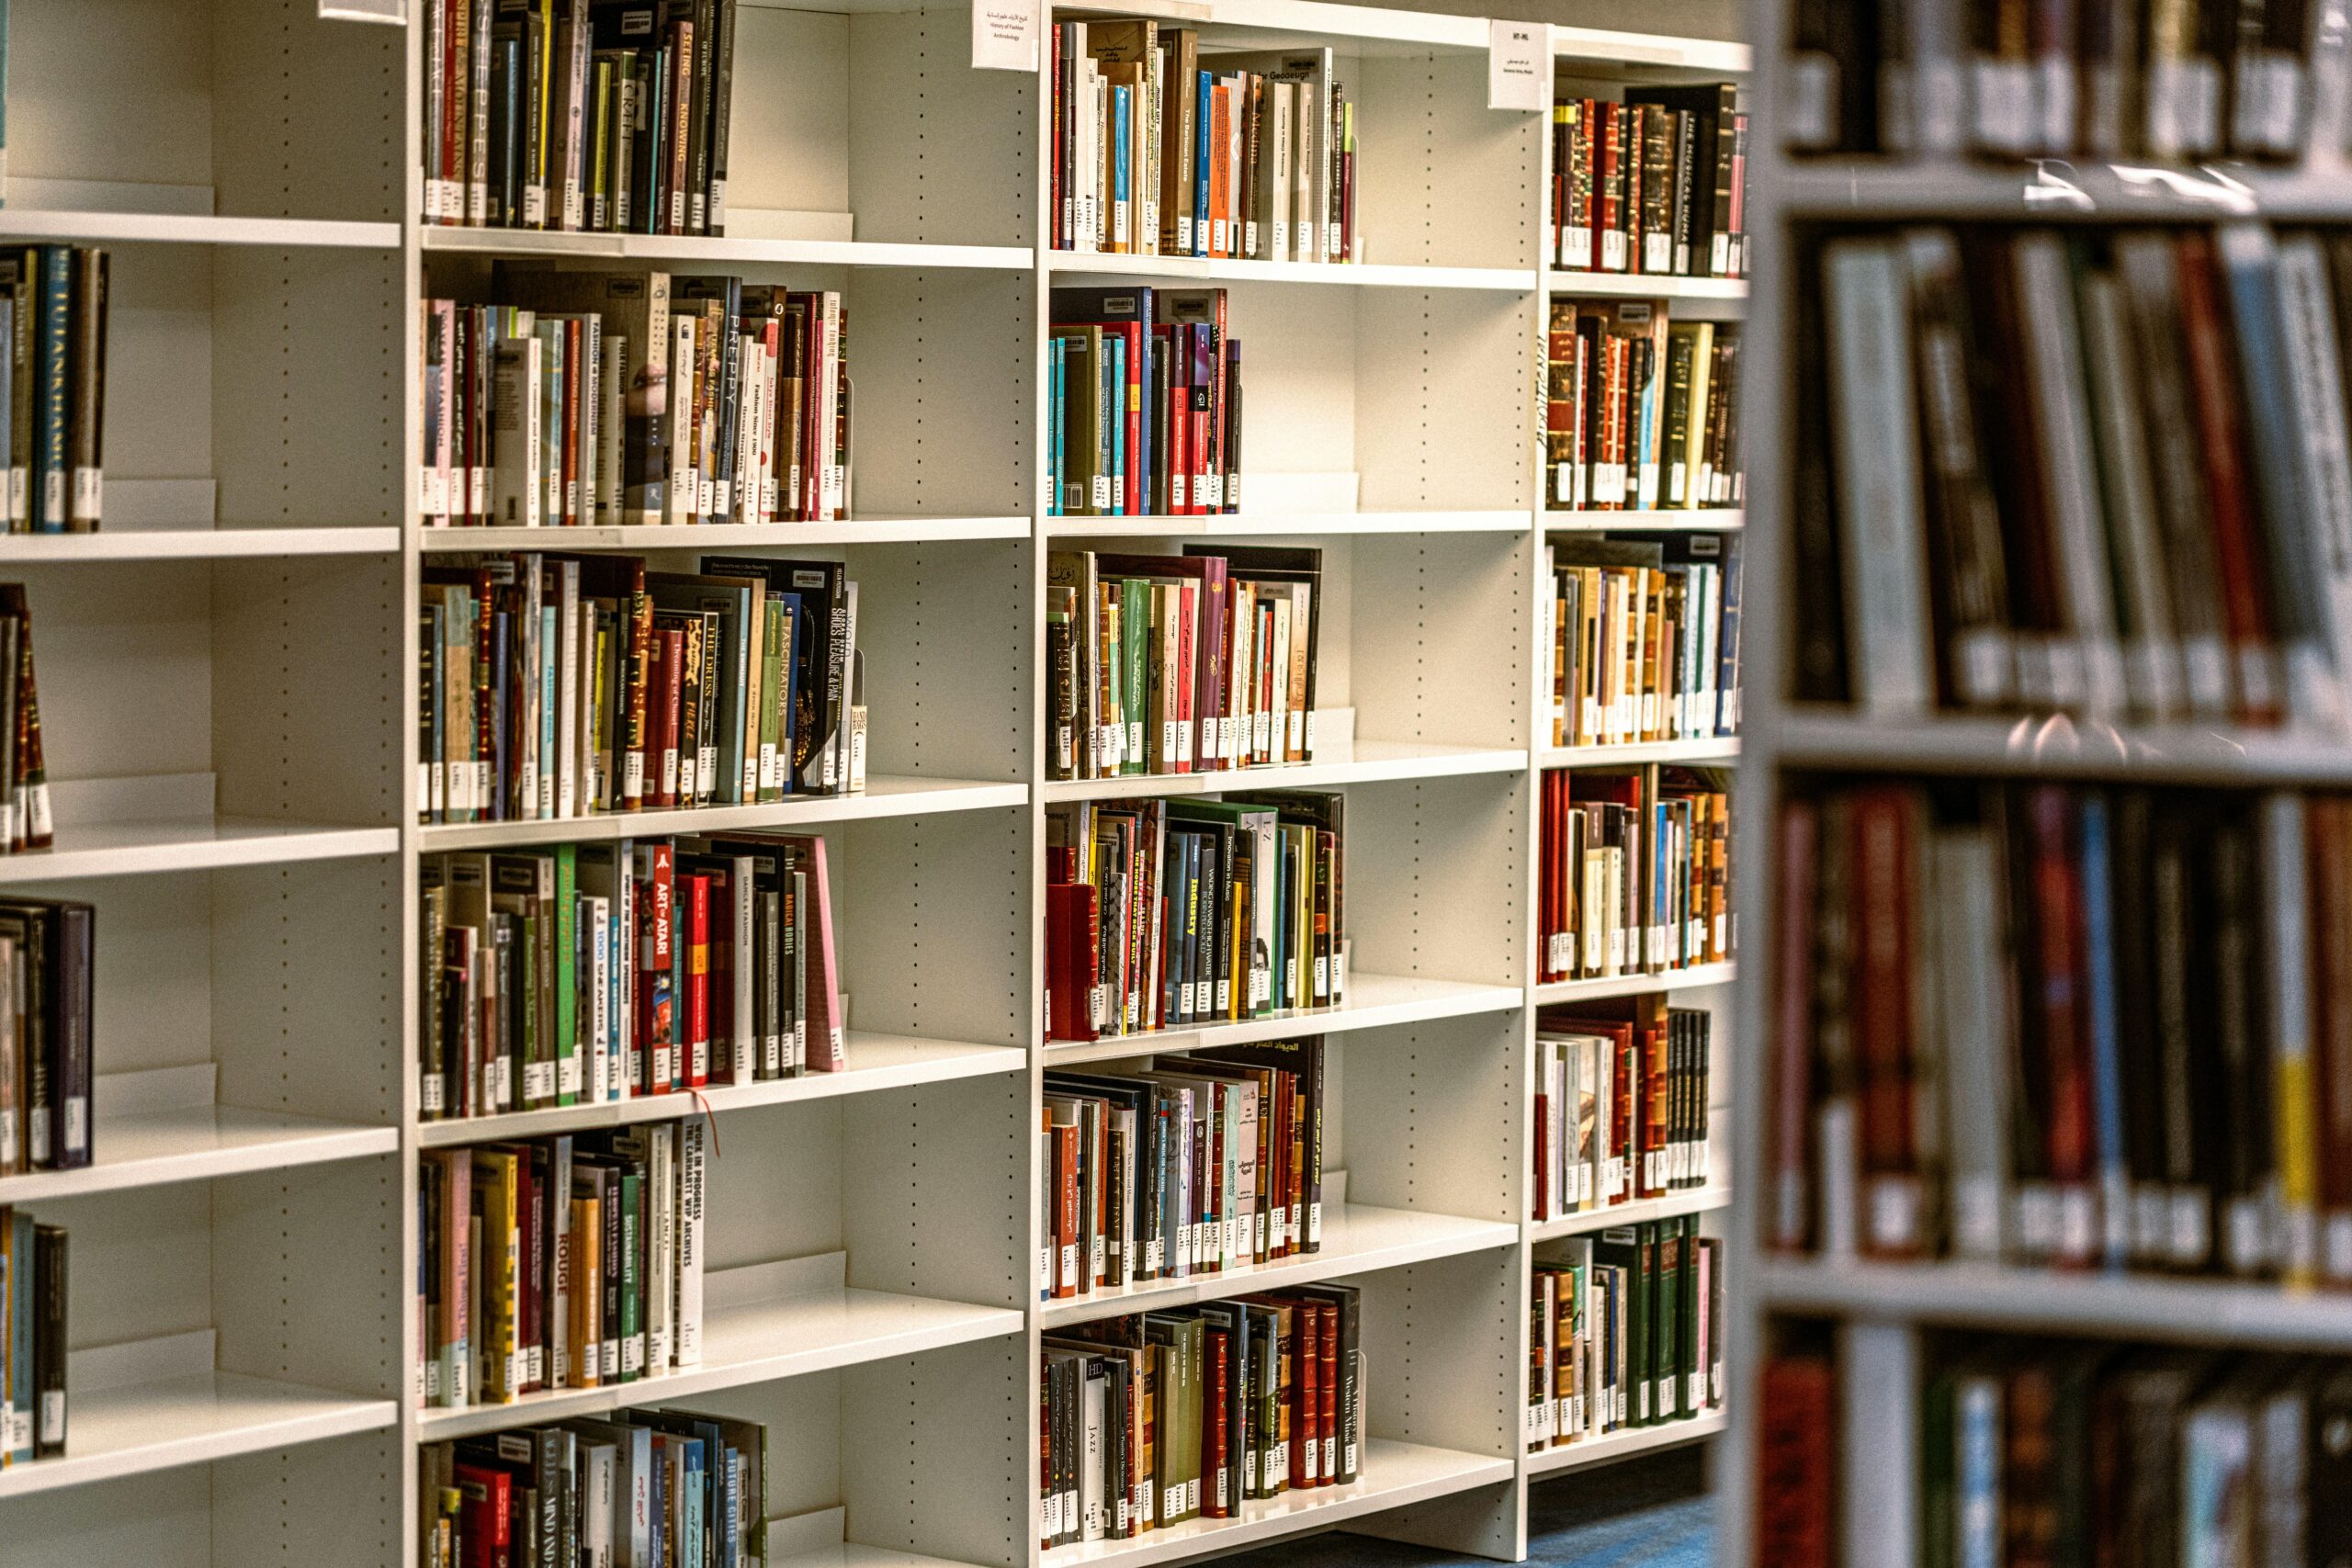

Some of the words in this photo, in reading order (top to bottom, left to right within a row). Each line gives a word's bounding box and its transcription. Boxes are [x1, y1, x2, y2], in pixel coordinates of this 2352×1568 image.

[473, 15, 489, 178] STEPPES
[1251, 113, 1261, 164] Medina
[1686, 117, 1694, 138] THE
[1679, 205, 1690, 243] HUMA
[618, 342, 627, 360] FOLK
[726, 315, 740, 405] PREPPY
[707, 625, 716, 652] THE
[830, 608, 842, 636] SHOES
[672, 644, 680, 683] Dreaming
[779, 626, 790, 716] FASCINATORS
[829, 639, 841, 675] PLEASURE
[705, 656, 715, 696] DRESS
[828, 685, 839, 701] PAIN
[671, 696, 679, 725] Chanel
[685, 701, 696, 739] FIERCE
[657, 883, 669, 908] ART
[786, 895, 794, 927] RADICAL
[1189, 879, 1198, 935] Industry
[657, 918, 669, 954] ATARI
[786, 928, 794, 954] BODIES
[686, 1124, 695, 1139] THE
[685, 1146, 694, 1193] CARHARTT
[694, 1156, 702, 1167] IN
[684, 1198, 693, 1216] WIP
[693, 1170, 702, 1220] PROGRESS
[625, 1214, 633, 1283] SUSTAINABILITY
[684, 1222, 692, 1267] ARCHIVES
[557, 1233, 569, 1295] ROUGE
[1089, 1426, 1097, 1453] JAZZ
[729, 1459, 737, 1501] FUTURE
[728, 1506, 736, 1543] CITIES
